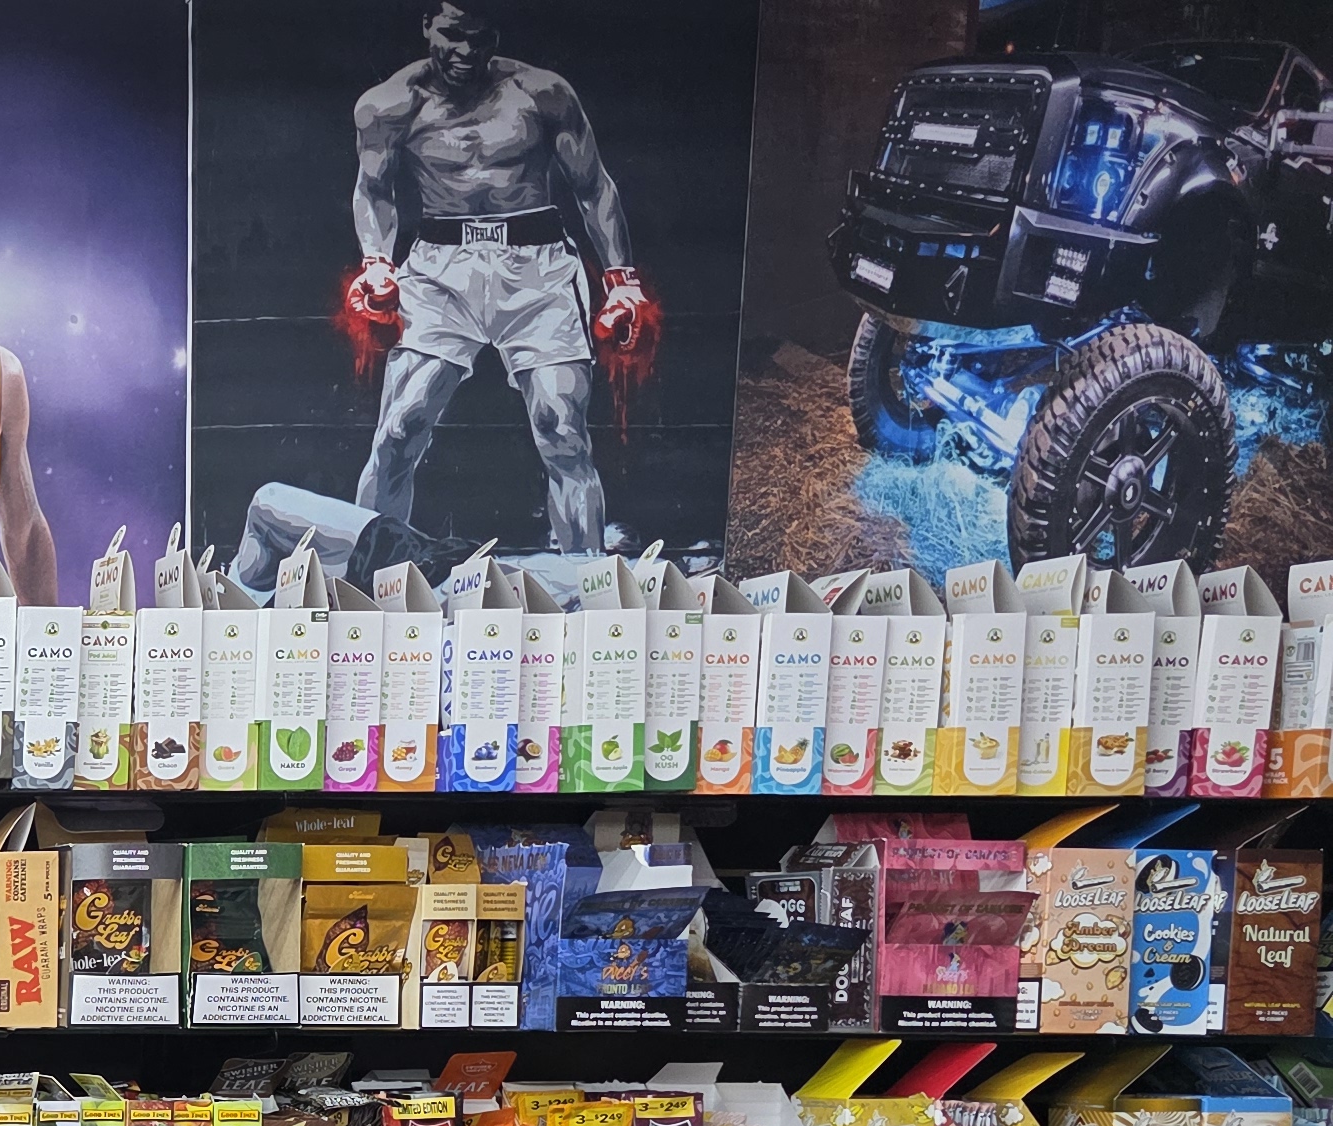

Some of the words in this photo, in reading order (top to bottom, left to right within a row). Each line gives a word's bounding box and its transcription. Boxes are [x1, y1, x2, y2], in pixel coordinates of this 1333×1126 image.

[464, 224, 505, 245] EVERLAST
[1219, 655, 1267, 665] CAMO
[39, 906, 48, 936] WRAPS
[1143, 924, 1194, 943] Cookies
[1243, 924, 1310, 944] Natural
[9, 916, 43, 1005] RAW
[41, 940, 51, 980] GUARANA
[1143, 946, 1192, 965] Cream
[1257, 945, 1292, 968] Leaf
[85, 996, 126, 1004] CONTAINS
[129, 996, 169, 1004] NICOTINE.
[98, 987, 116, 995] THIS
[121, 987, 158, 995] PRODUCT
[126, 1015, 170, 1023] CHEMICAL.
